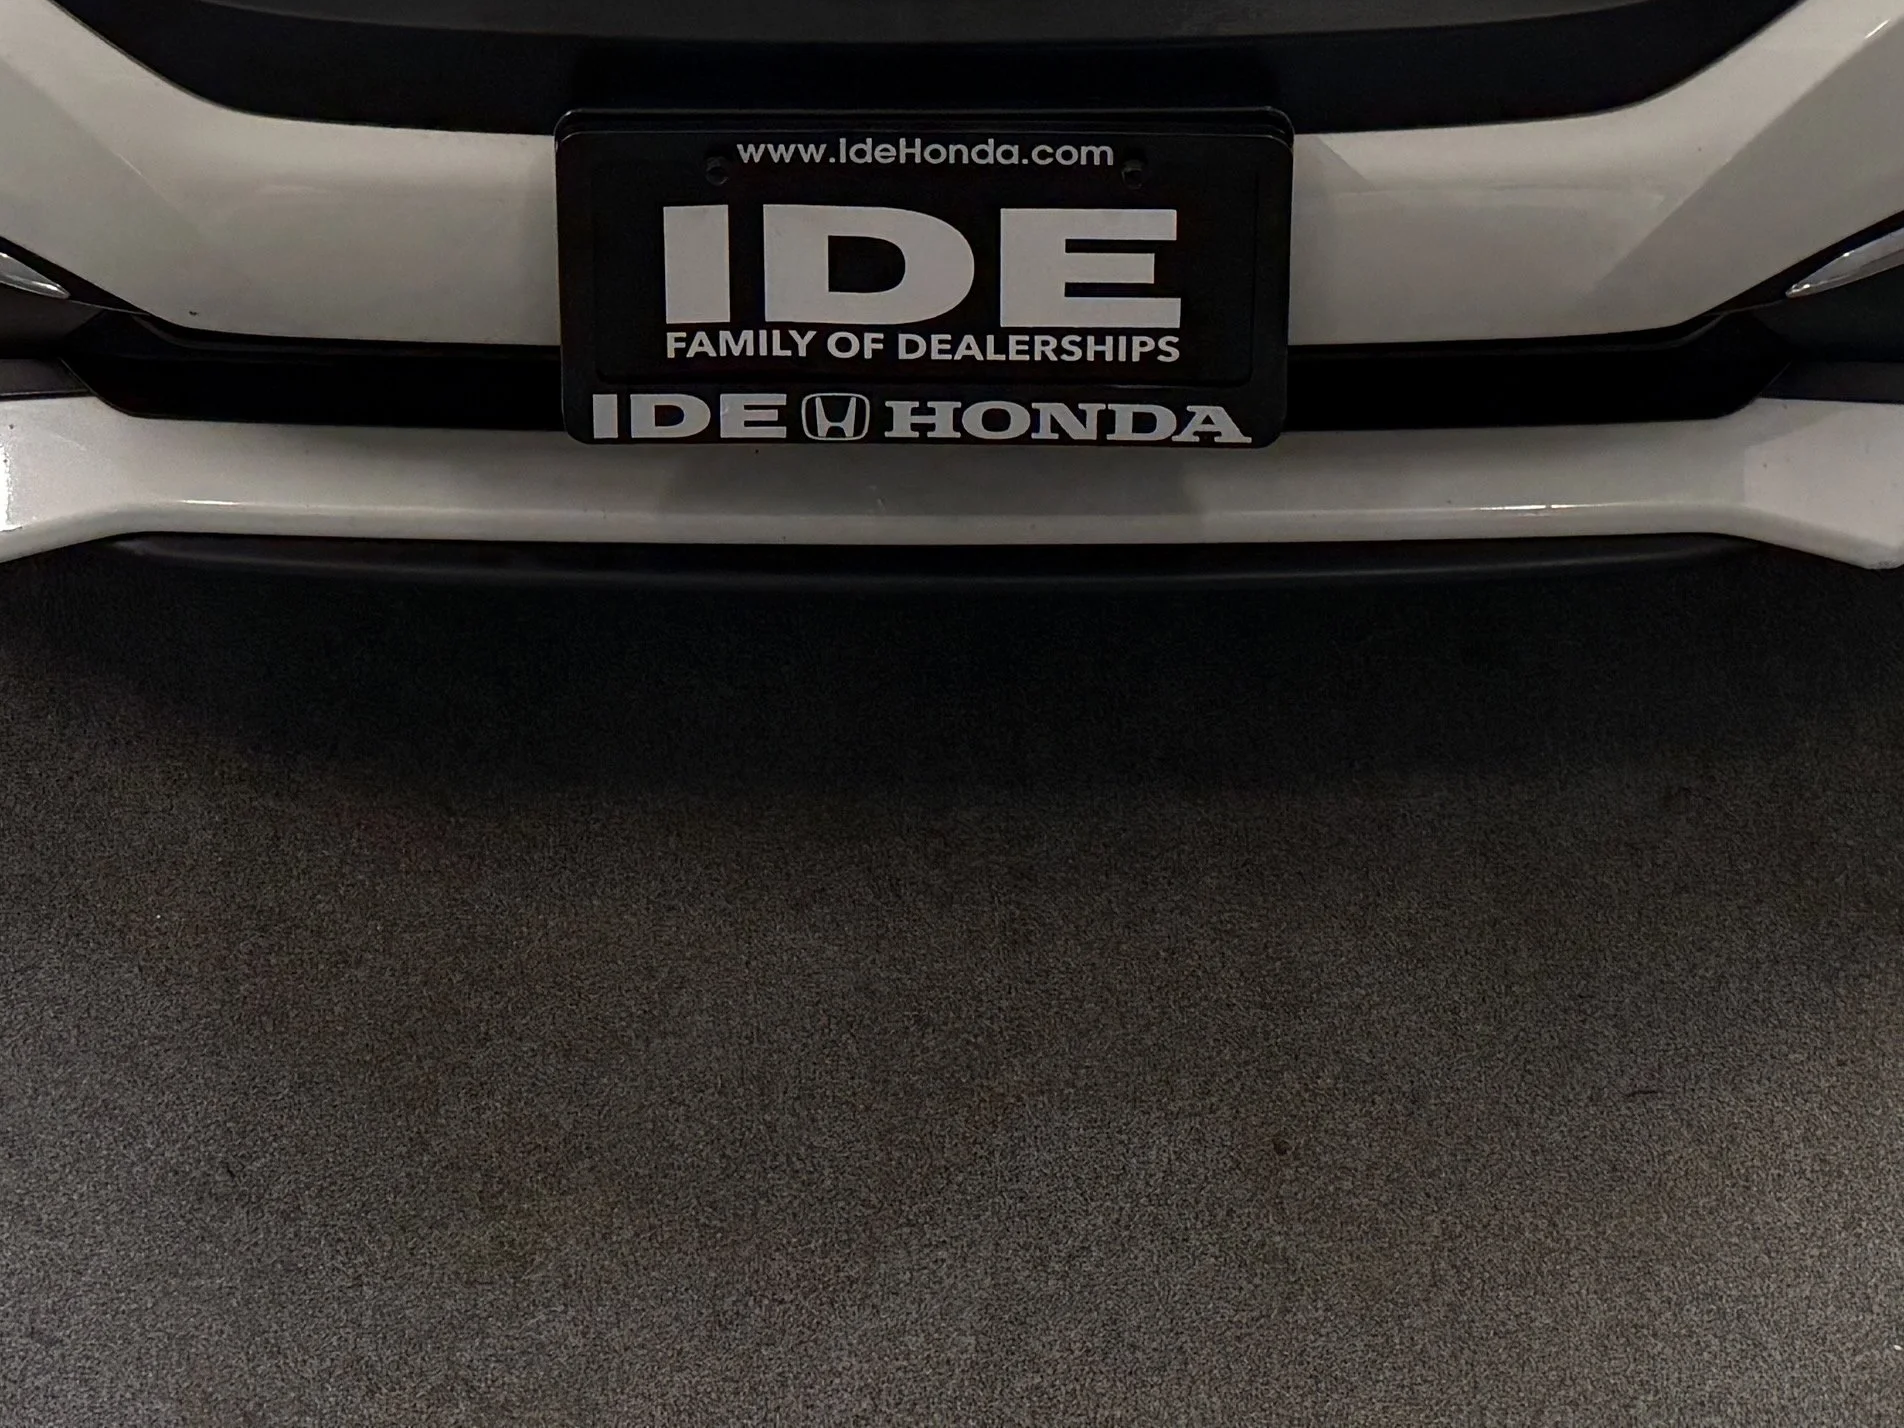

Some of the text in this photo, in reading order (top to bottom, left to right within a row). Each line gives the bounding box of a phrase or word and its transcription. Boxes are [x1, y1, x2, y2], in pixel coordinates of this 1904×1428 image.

[736, 137, 1114, 166] www.IdeHonda.com
[662, 203, 1182, 329] IDE
[666, 329, 1180, 363] FAMILY OF DEALERSHIPS
[592, 393, 1253, 444] IDE HONDA
